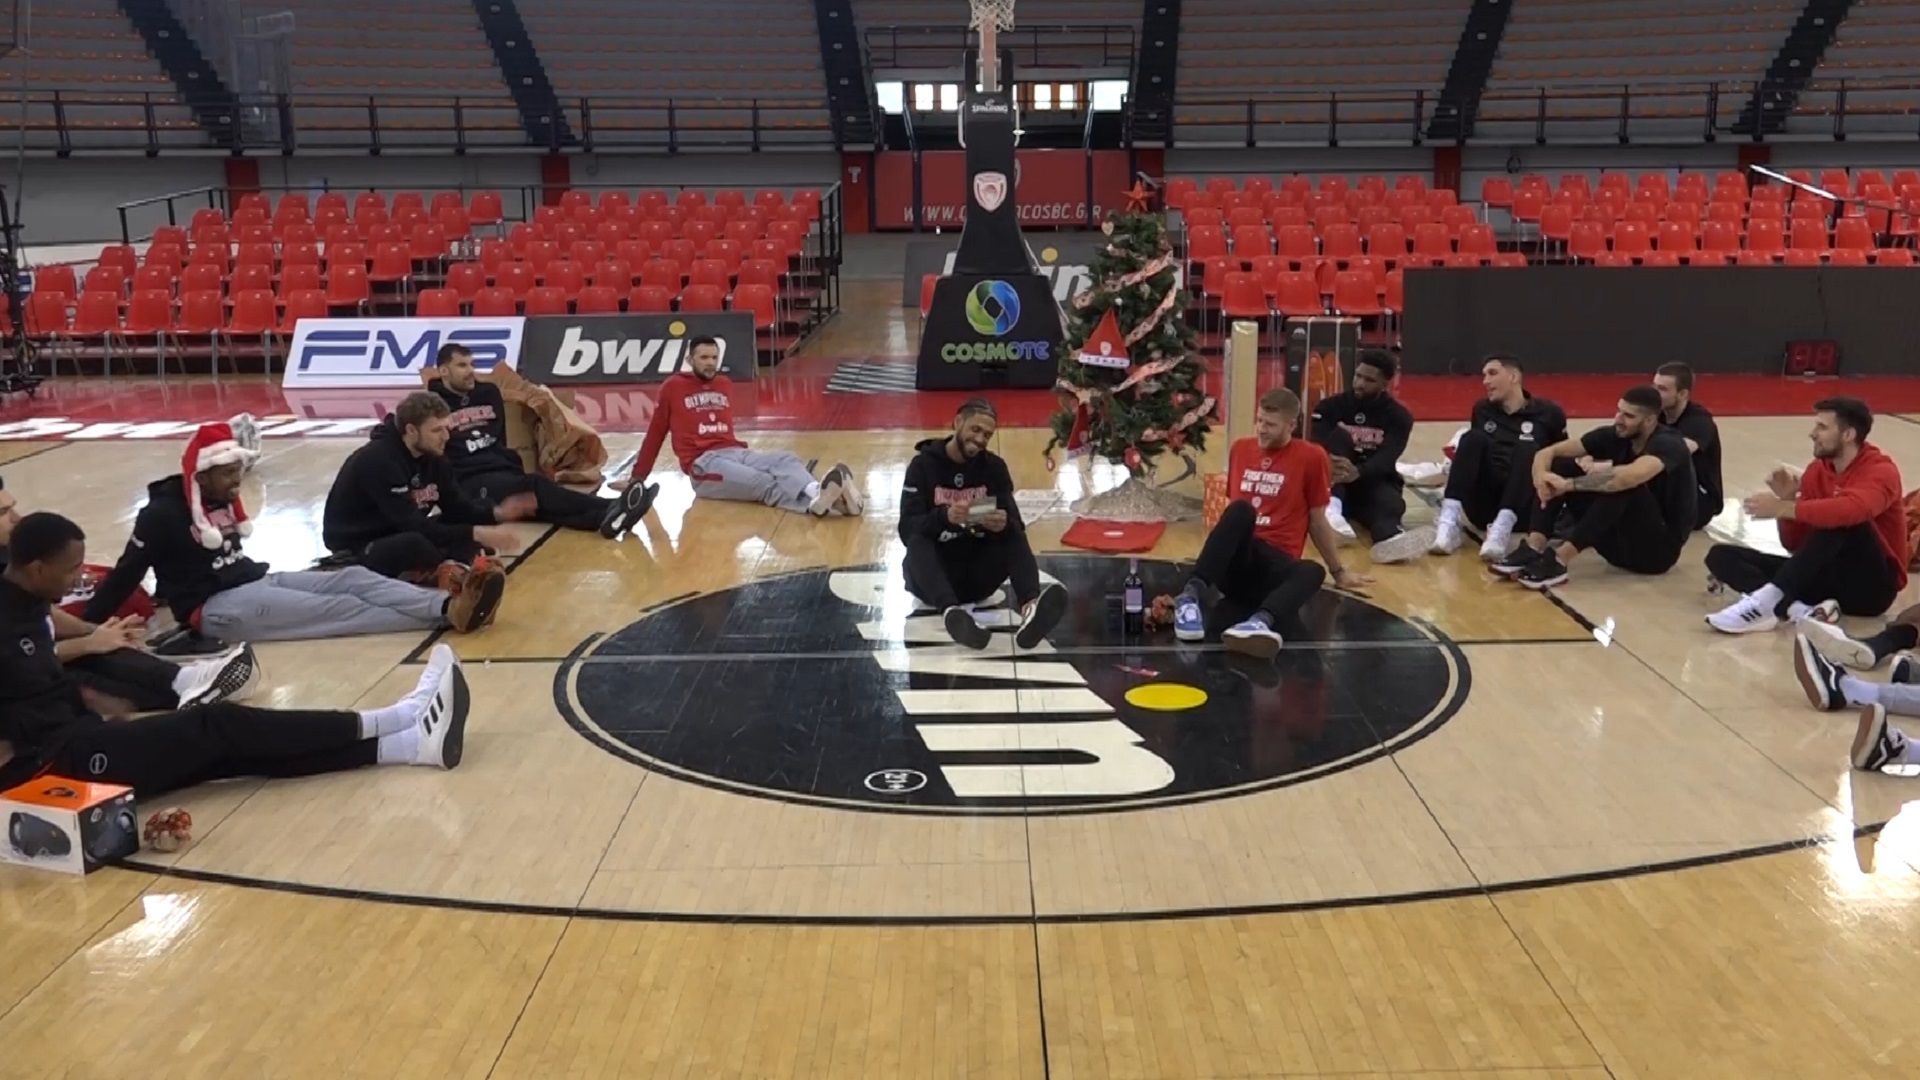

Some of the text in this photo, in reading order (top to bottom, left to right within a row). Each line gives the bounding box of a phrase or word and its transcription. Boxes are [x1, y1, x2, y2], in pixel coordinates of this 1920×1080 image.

[297, 329, 512, 371] FMS
[941, 341, 1050, 363] COSMOTE
[1255, 512, 1272, 526] in
